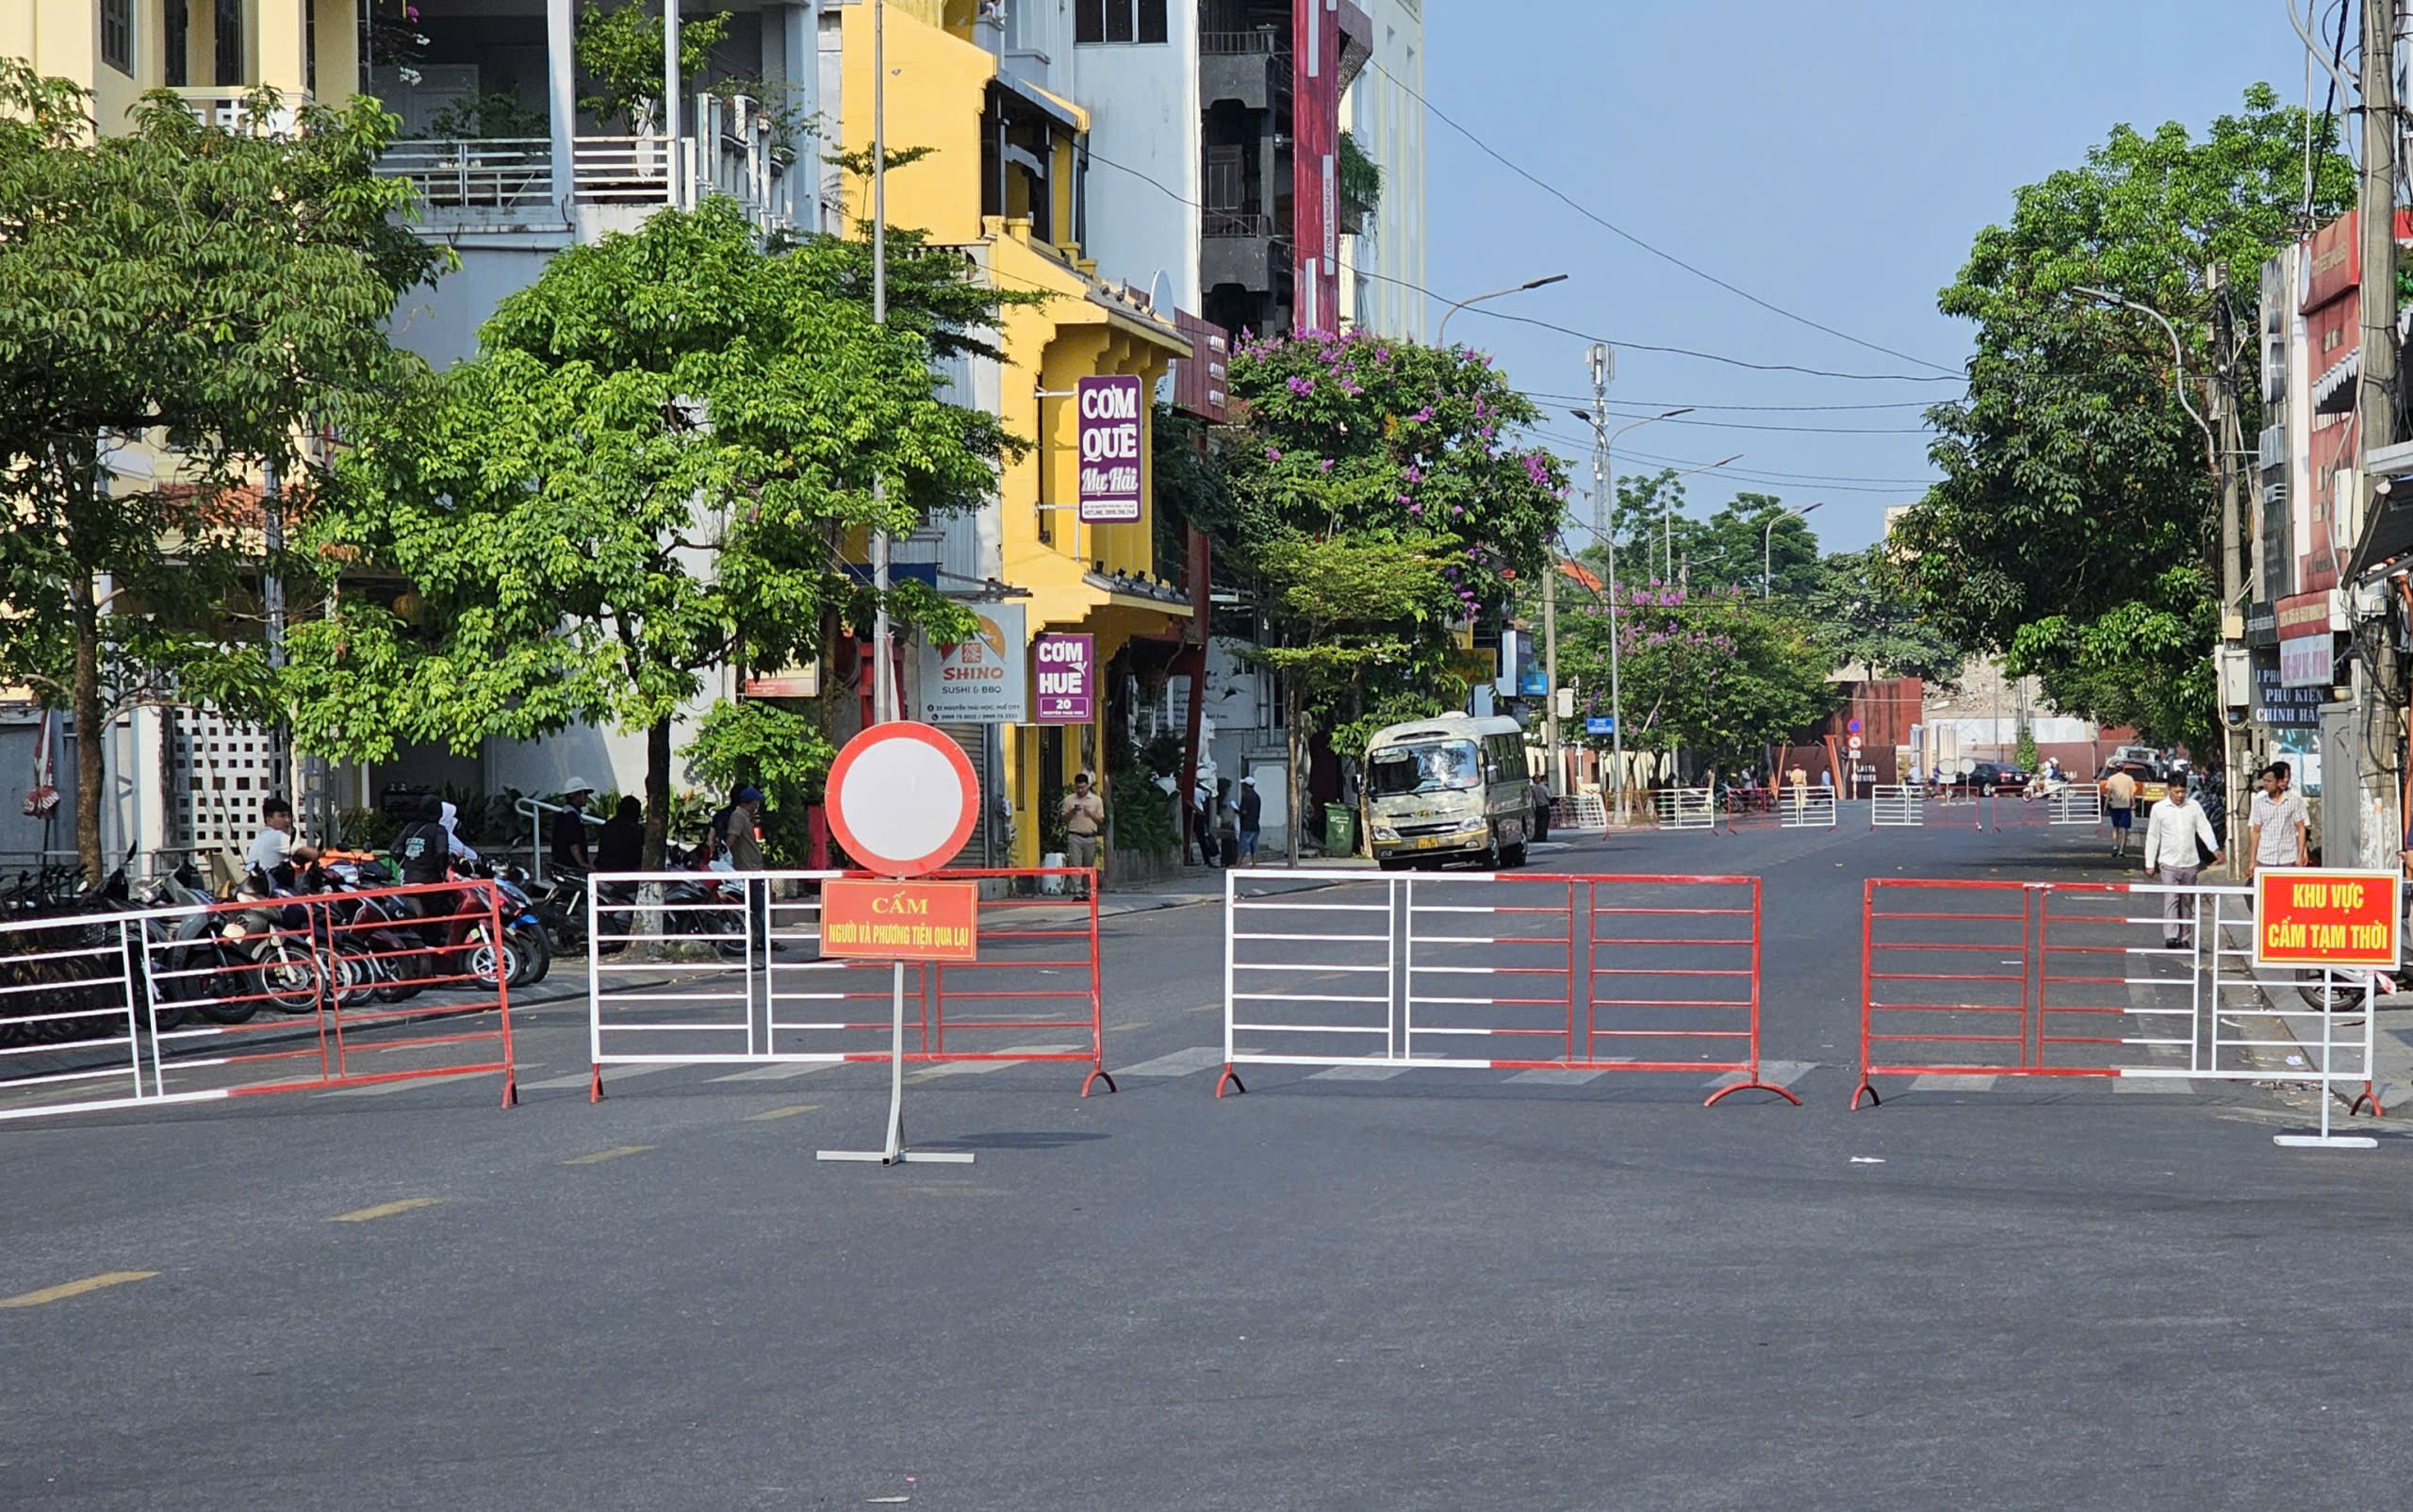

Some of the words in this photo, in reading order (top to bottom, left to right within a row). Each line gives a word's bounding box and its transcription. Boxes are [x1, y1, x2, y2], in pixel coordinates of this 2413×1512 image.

[1082, 384, 1137, 419] CƠM
[1082, 423, 1138, 462] QUÊ
[1039, 640, 1083, 662] CƠM
[944, 666, 1004, 681] SHINO
[982, 685, 1002, 694] BBQ
[2265, 688, 2291, 705] PHỤ
[1056, 698, 1072, 710] 20
[2256, 705, 2295, 722] CHÍNH
[871, 890, 928, 914] CẤM
[2292, 883, 2327, 909] KHU
[2331, 881, 2364, 913] VỰC
[829, 920, 857, 944] NGƯỜI
[859, 921, 872, 944] VÀ
[873, 924, 911, 945] PHƯƠNG
[912, 922, 932, 949] TIỆN
[934, 927, 952, 948] QUA
[954, 928, 969, 951] LẠI
[2268, 915, 2306, 948] CẤM
[2309, 924, 2346, 954] TẠM
[2350, 920, 2388, 949] THỜI
